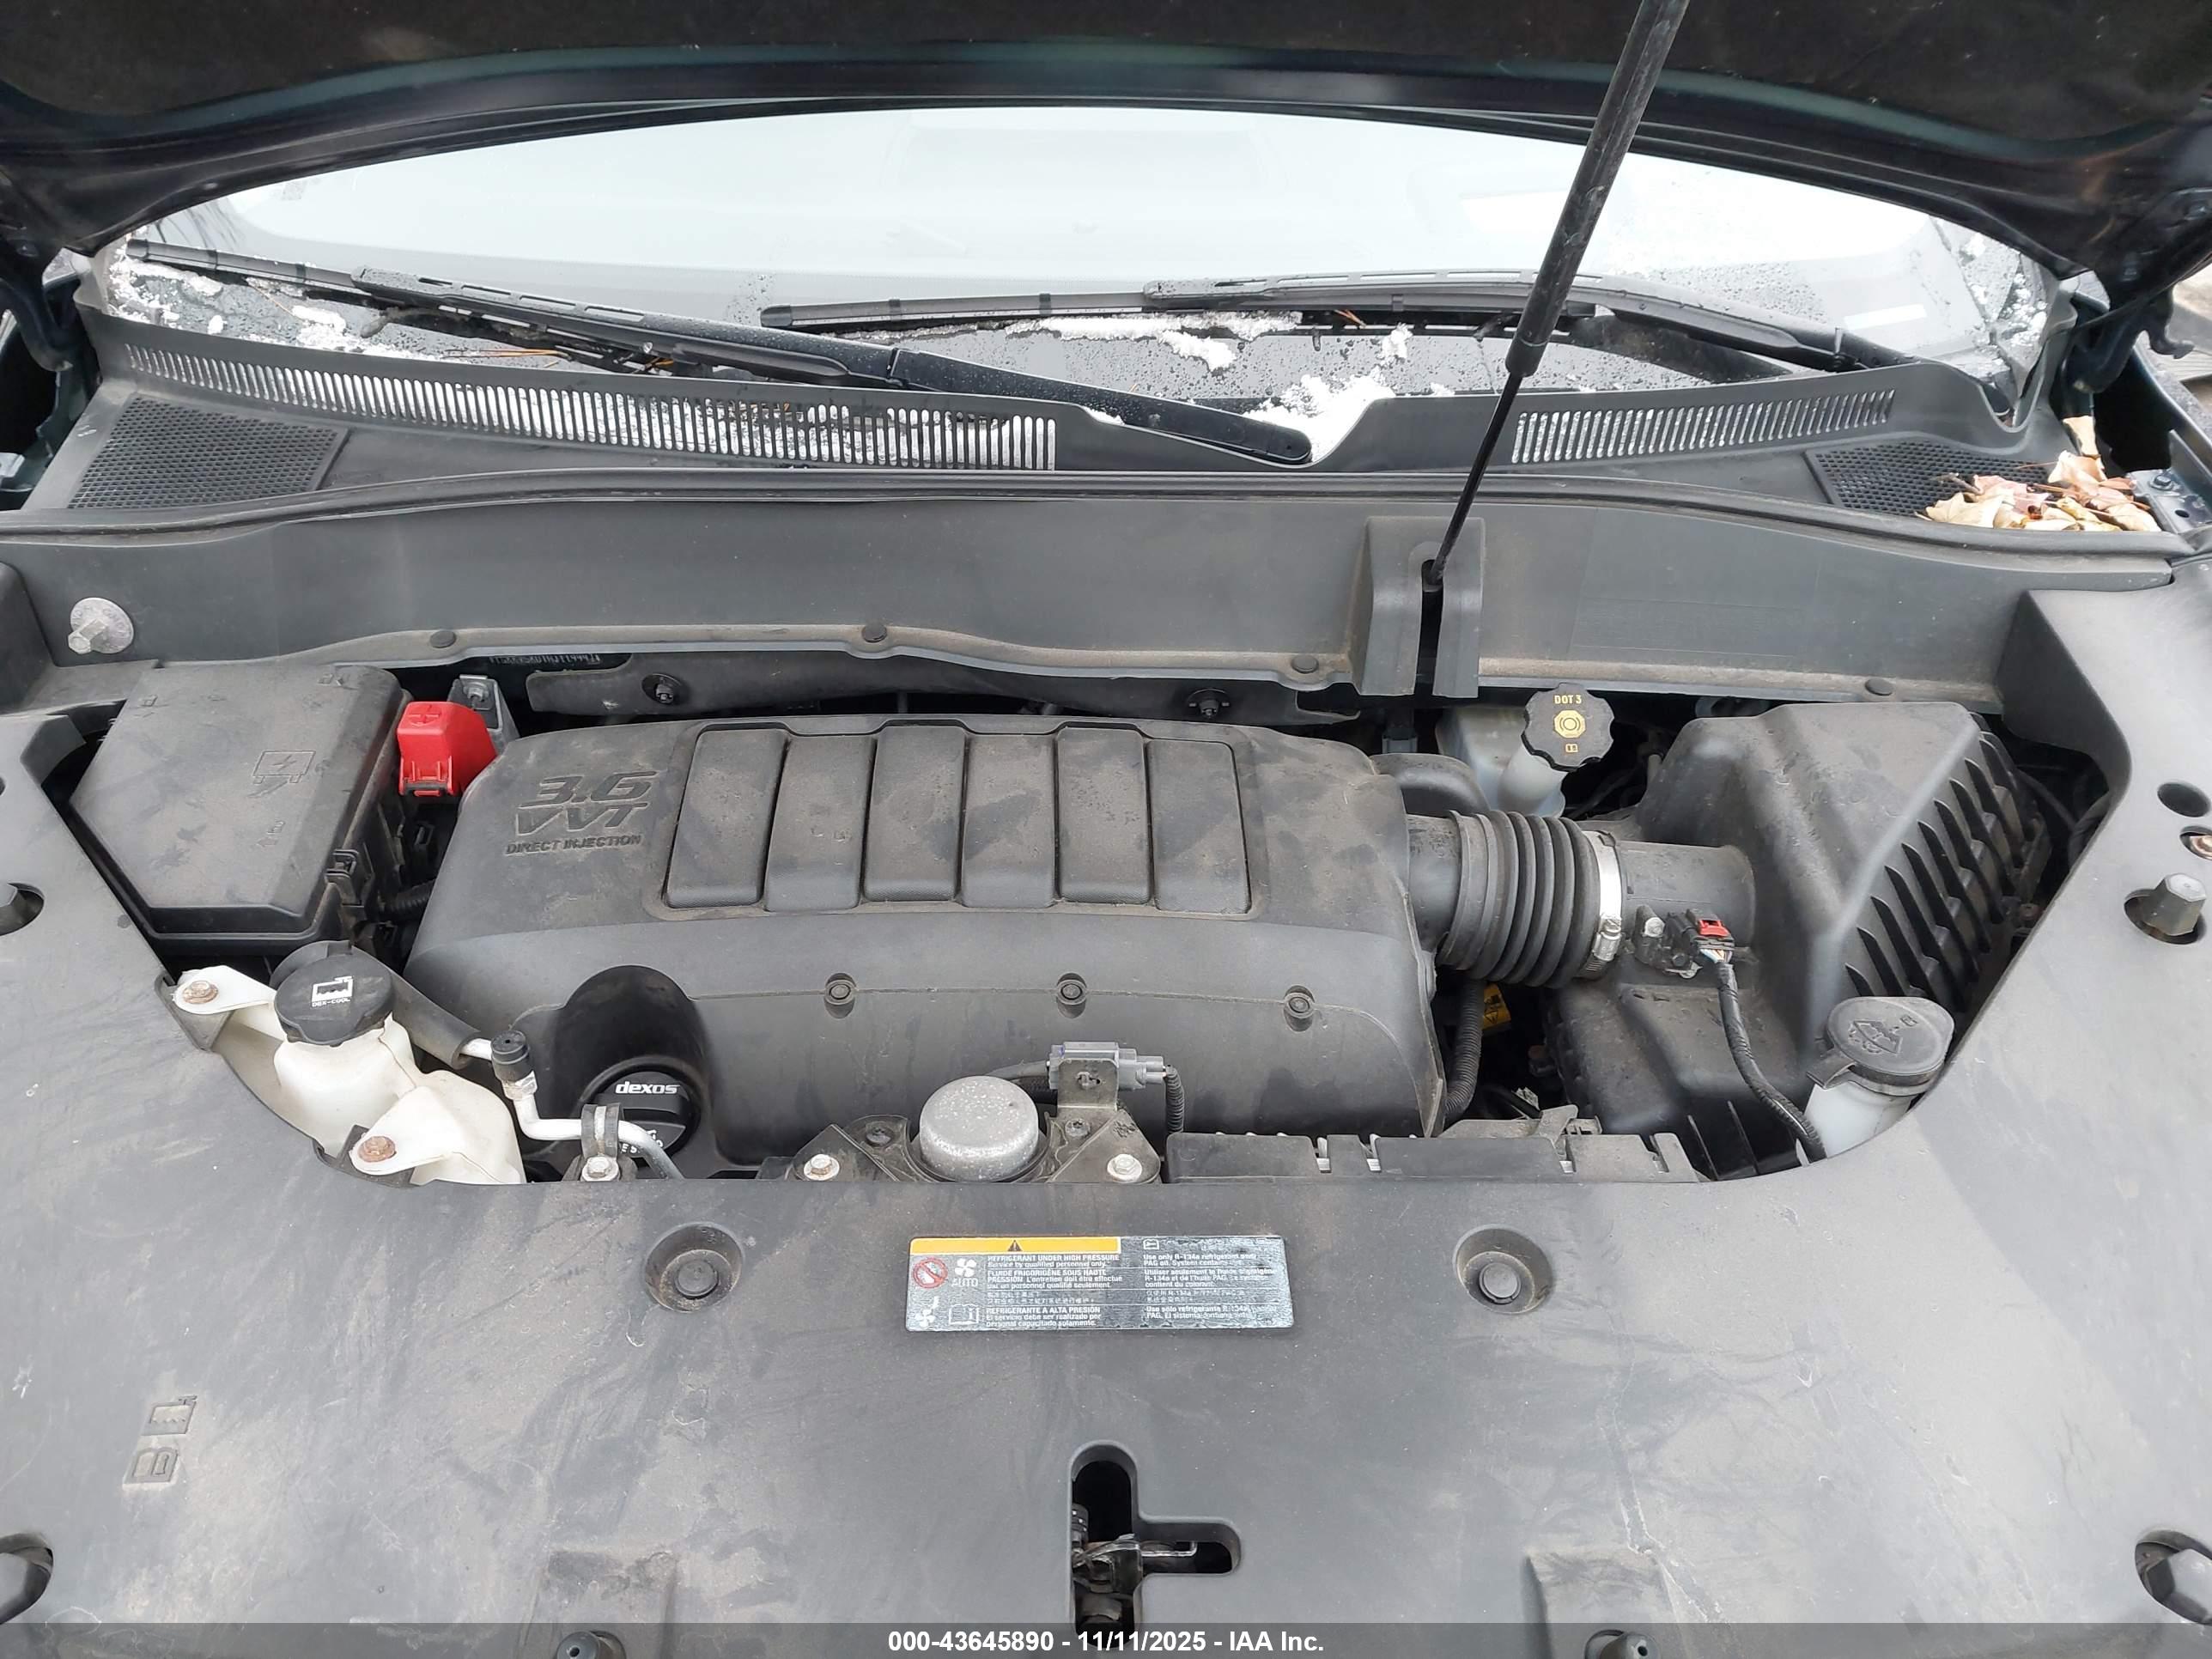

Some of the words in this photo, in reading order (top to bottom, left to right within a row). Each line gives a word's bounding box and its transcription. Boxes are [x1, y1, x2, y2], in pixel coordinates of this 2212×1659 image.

[1554, 695, 1574, 704] DOT
[1576, 695, 1582, 704] 3
[519, 772, 657, 807] 3.6
[516, 803, 649, 836] VVT
[505, 840, 559, 854] DIRECT
[563, 835, 641, 850] INJECTION
[616, 1081, 680, 1094] dexos
[951, 1279, 978, 1287] AUTO
